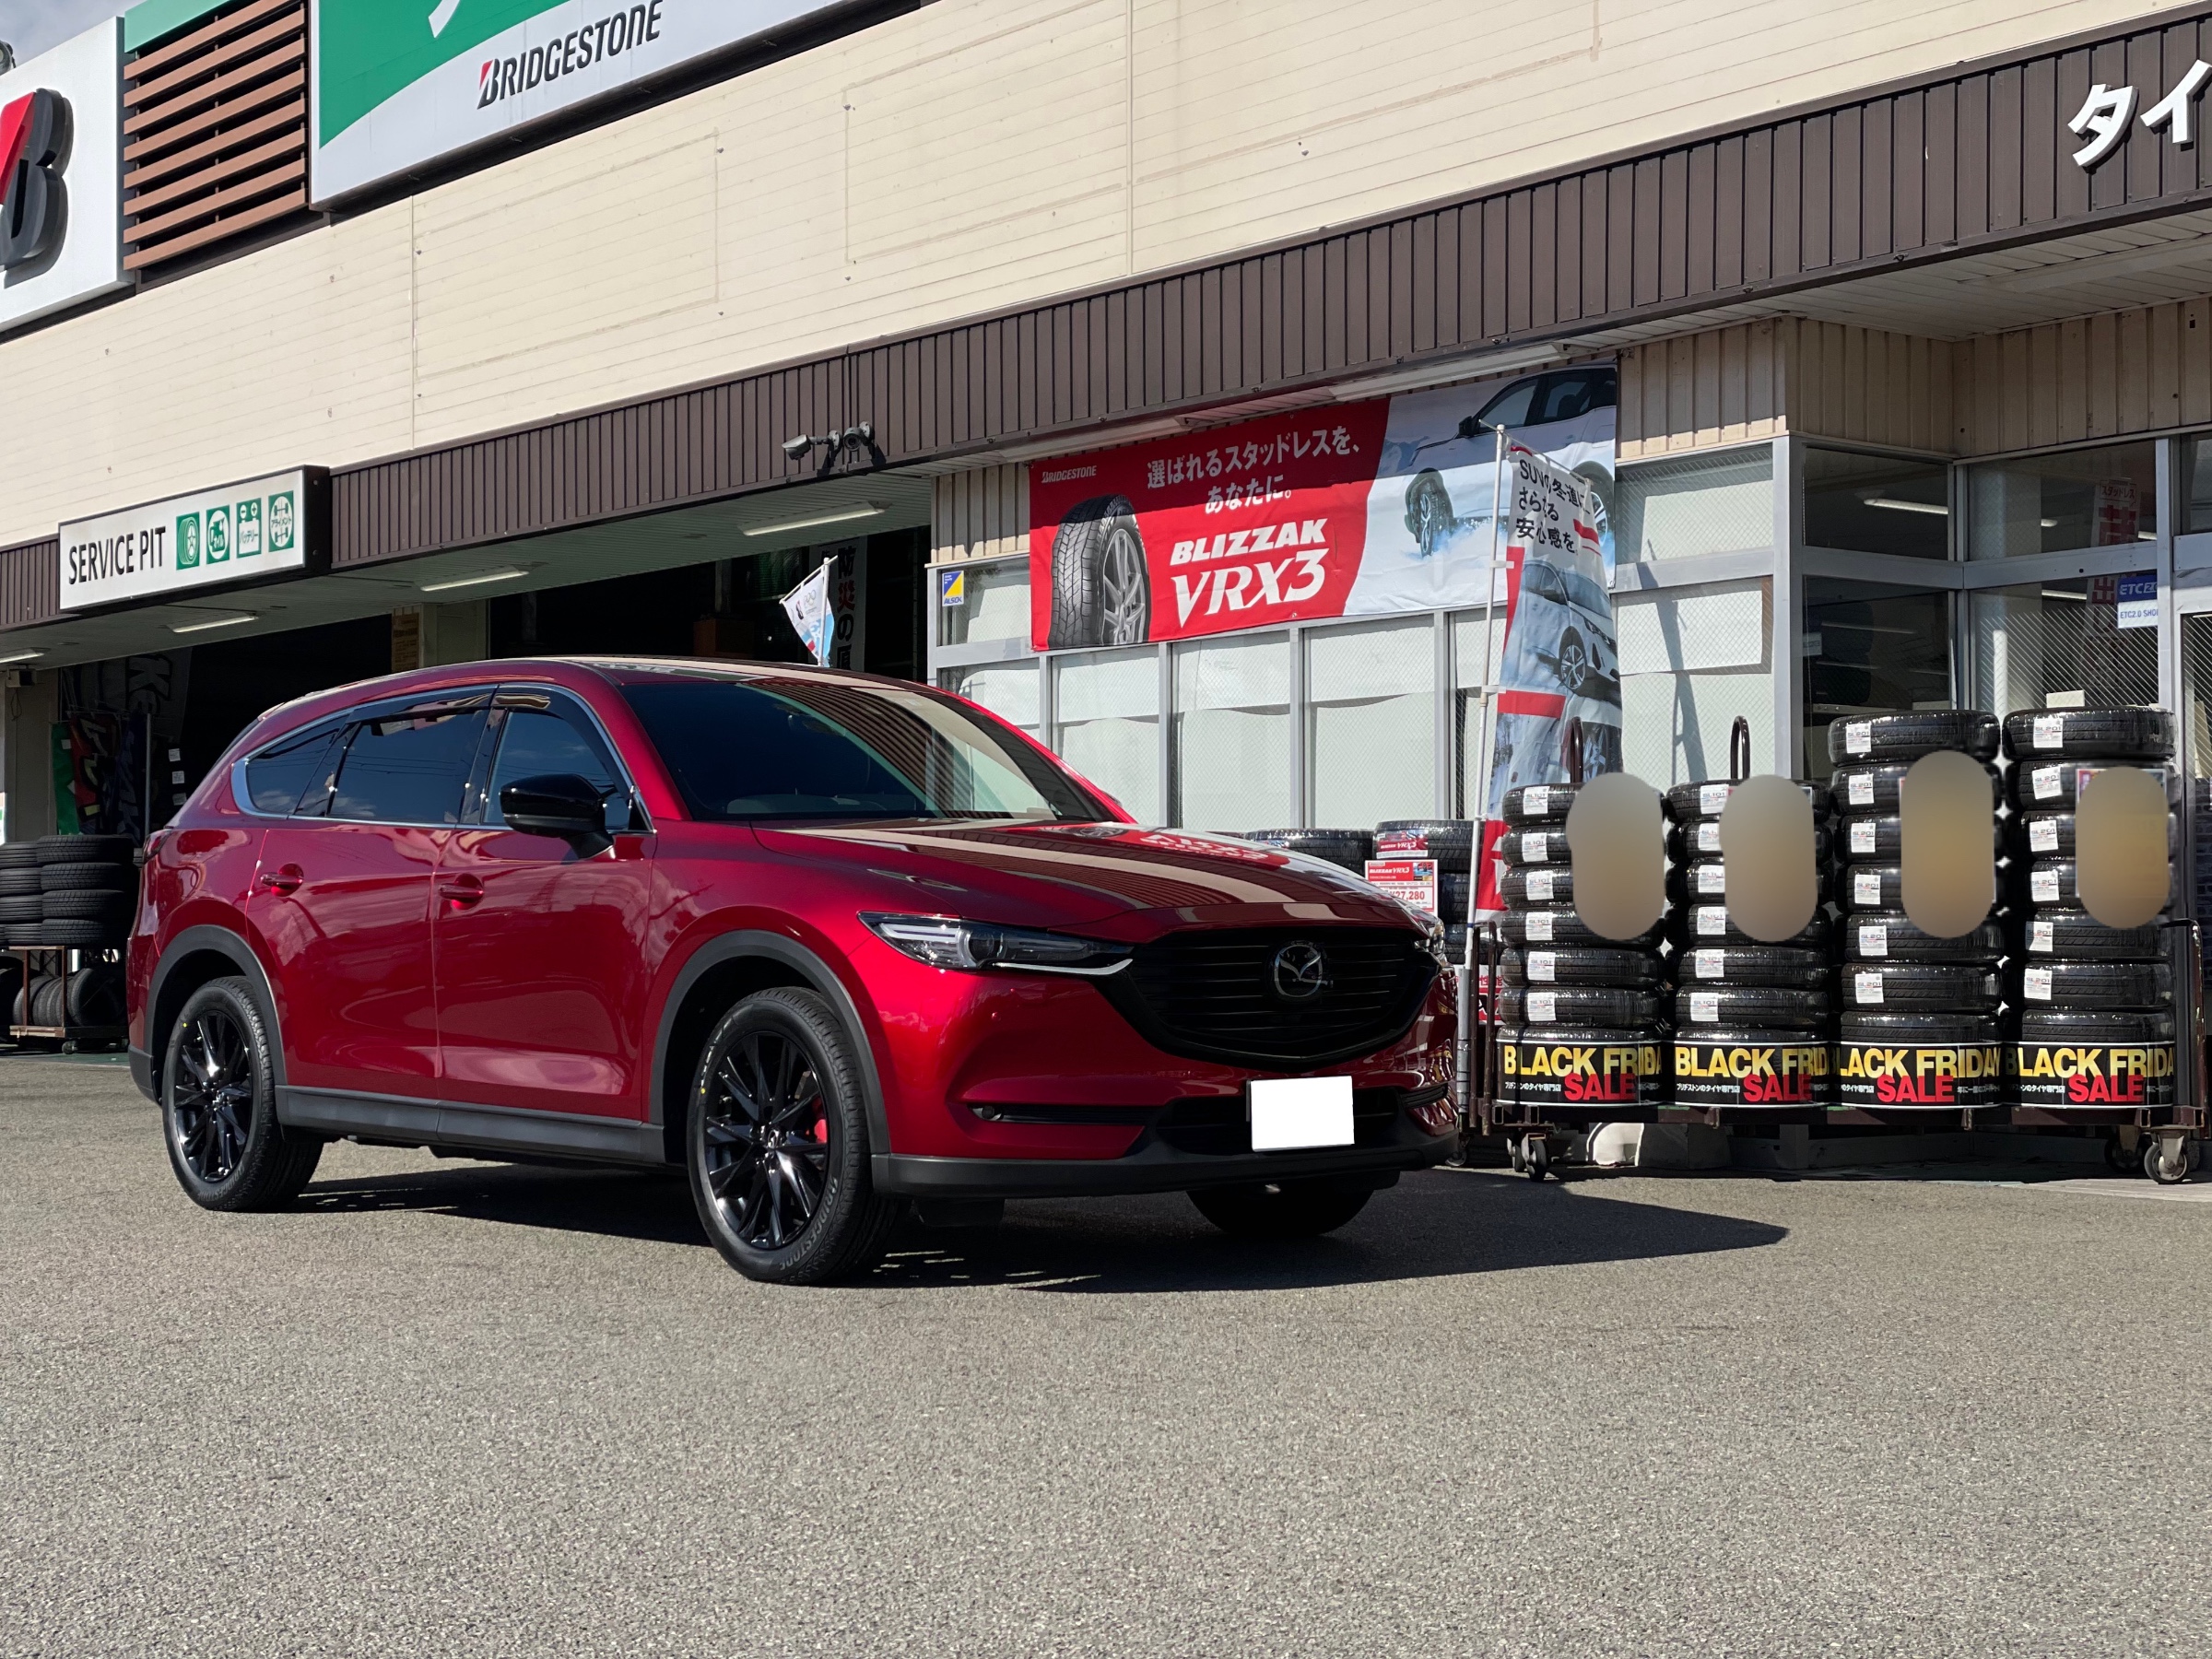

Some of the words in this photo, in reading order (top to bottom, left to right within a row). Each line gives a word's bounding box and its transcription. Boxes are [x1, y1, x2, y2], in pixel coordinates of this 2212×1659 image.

[477, 0, 664, 110] BRIDGESTONE
[2067, 59, 2212, 168] タイ
[1147, 425, 1360, 490] 選ばれるスタッドレスを、
[1041, 465, 1098, 484] BRIDGESTONE
[1205, 474, 1292, 514] あなたに。
[68, 533, 135, 585] SERVICE
[139, 525, 166, 571] PIT
[1170, 518, 1328, 566] BLIZZAK
[1171, 547, 1329, 629] VRX3
[2143, 608, 2159, 617] SHO
[1504, 1044, 1600, 1077] BLACK
[1675, 1046, 1776, 1078] BLACK
[1916, 1046, 2002, 1079] FRIDAY
[1564, 1073, 1637, 1101] SALE
[1743, 1074, 1812, 1102] SALE
[1877, 1074, 1955, 1103] SALE
[2068, 1075, 2144, 1103] SALE
